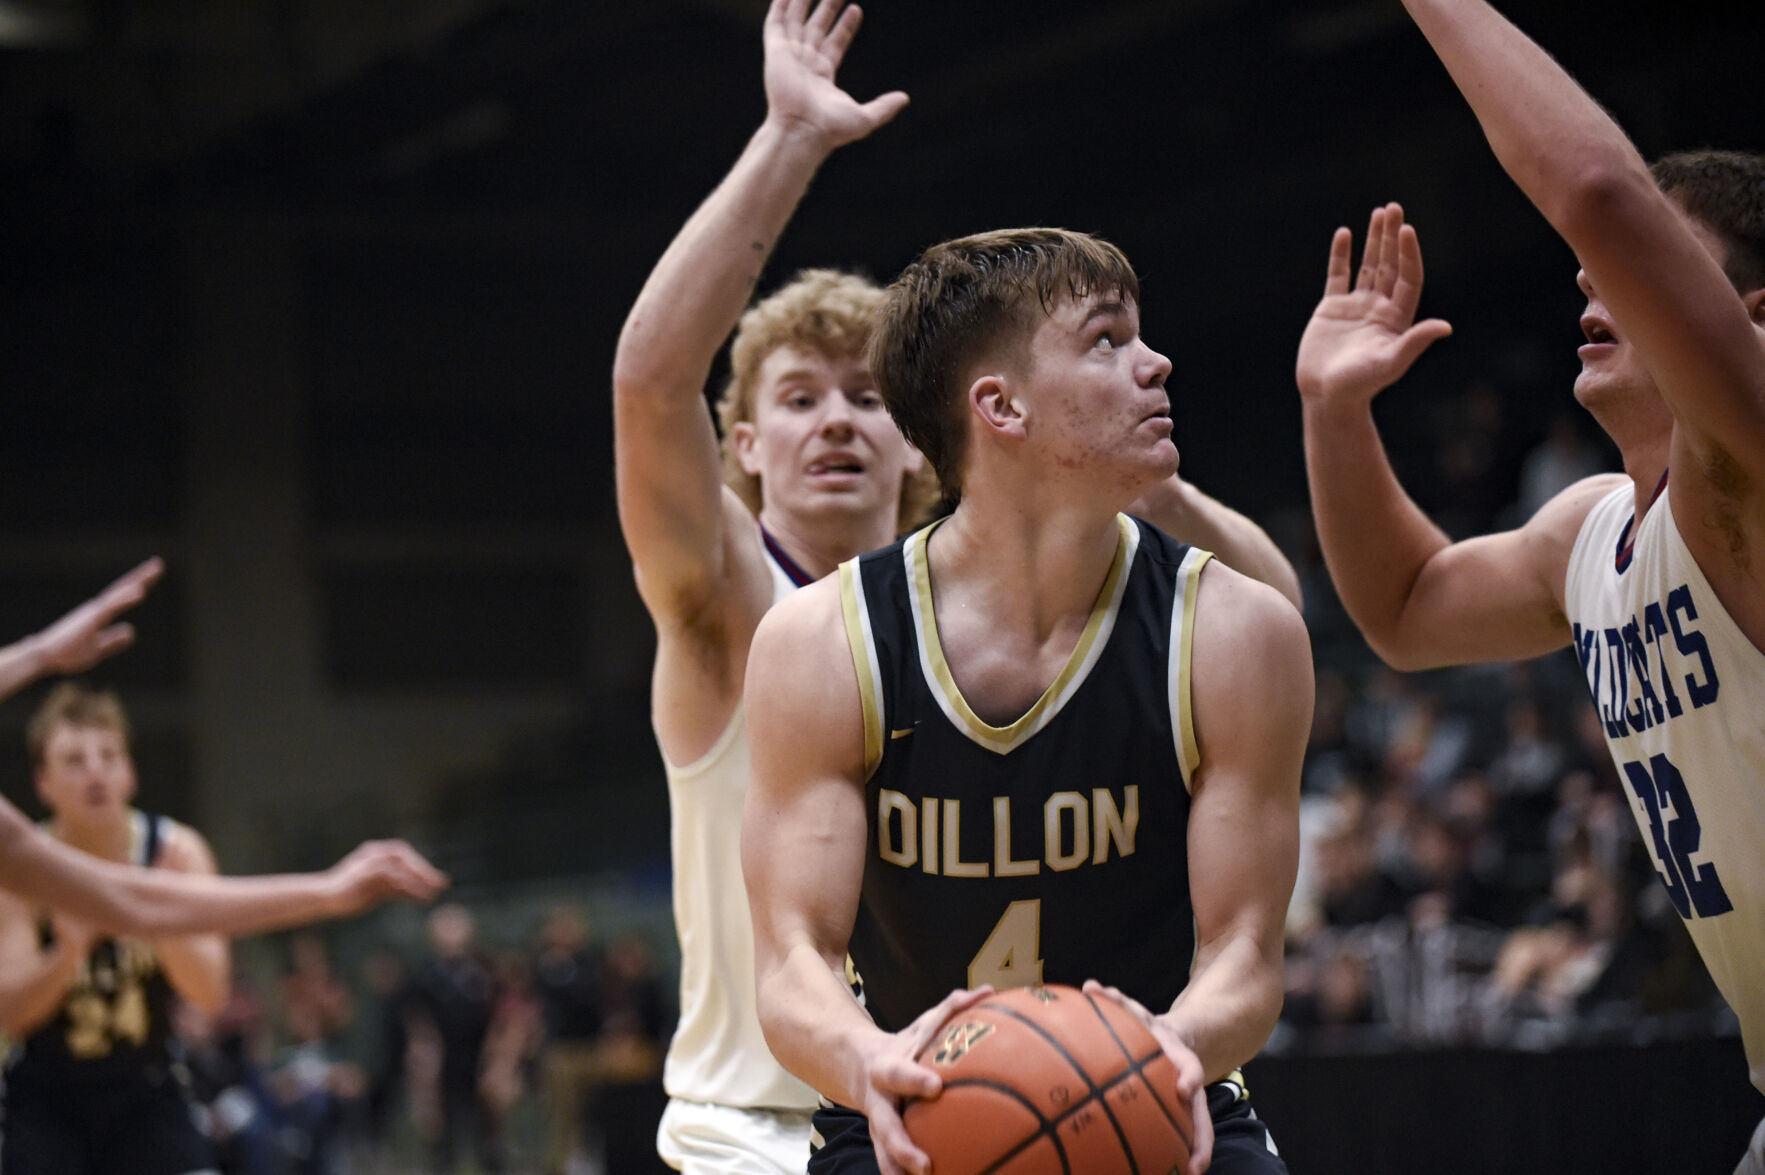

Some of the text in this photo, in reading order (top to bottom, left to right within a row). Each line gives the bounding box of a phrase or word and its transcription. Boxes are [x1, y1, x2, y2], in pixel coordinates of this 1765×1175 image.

[878, 785, 1139, 878] DILLON
[1623, 753, 1734, 919] 32
[968, 898, 1044, 990] 4
